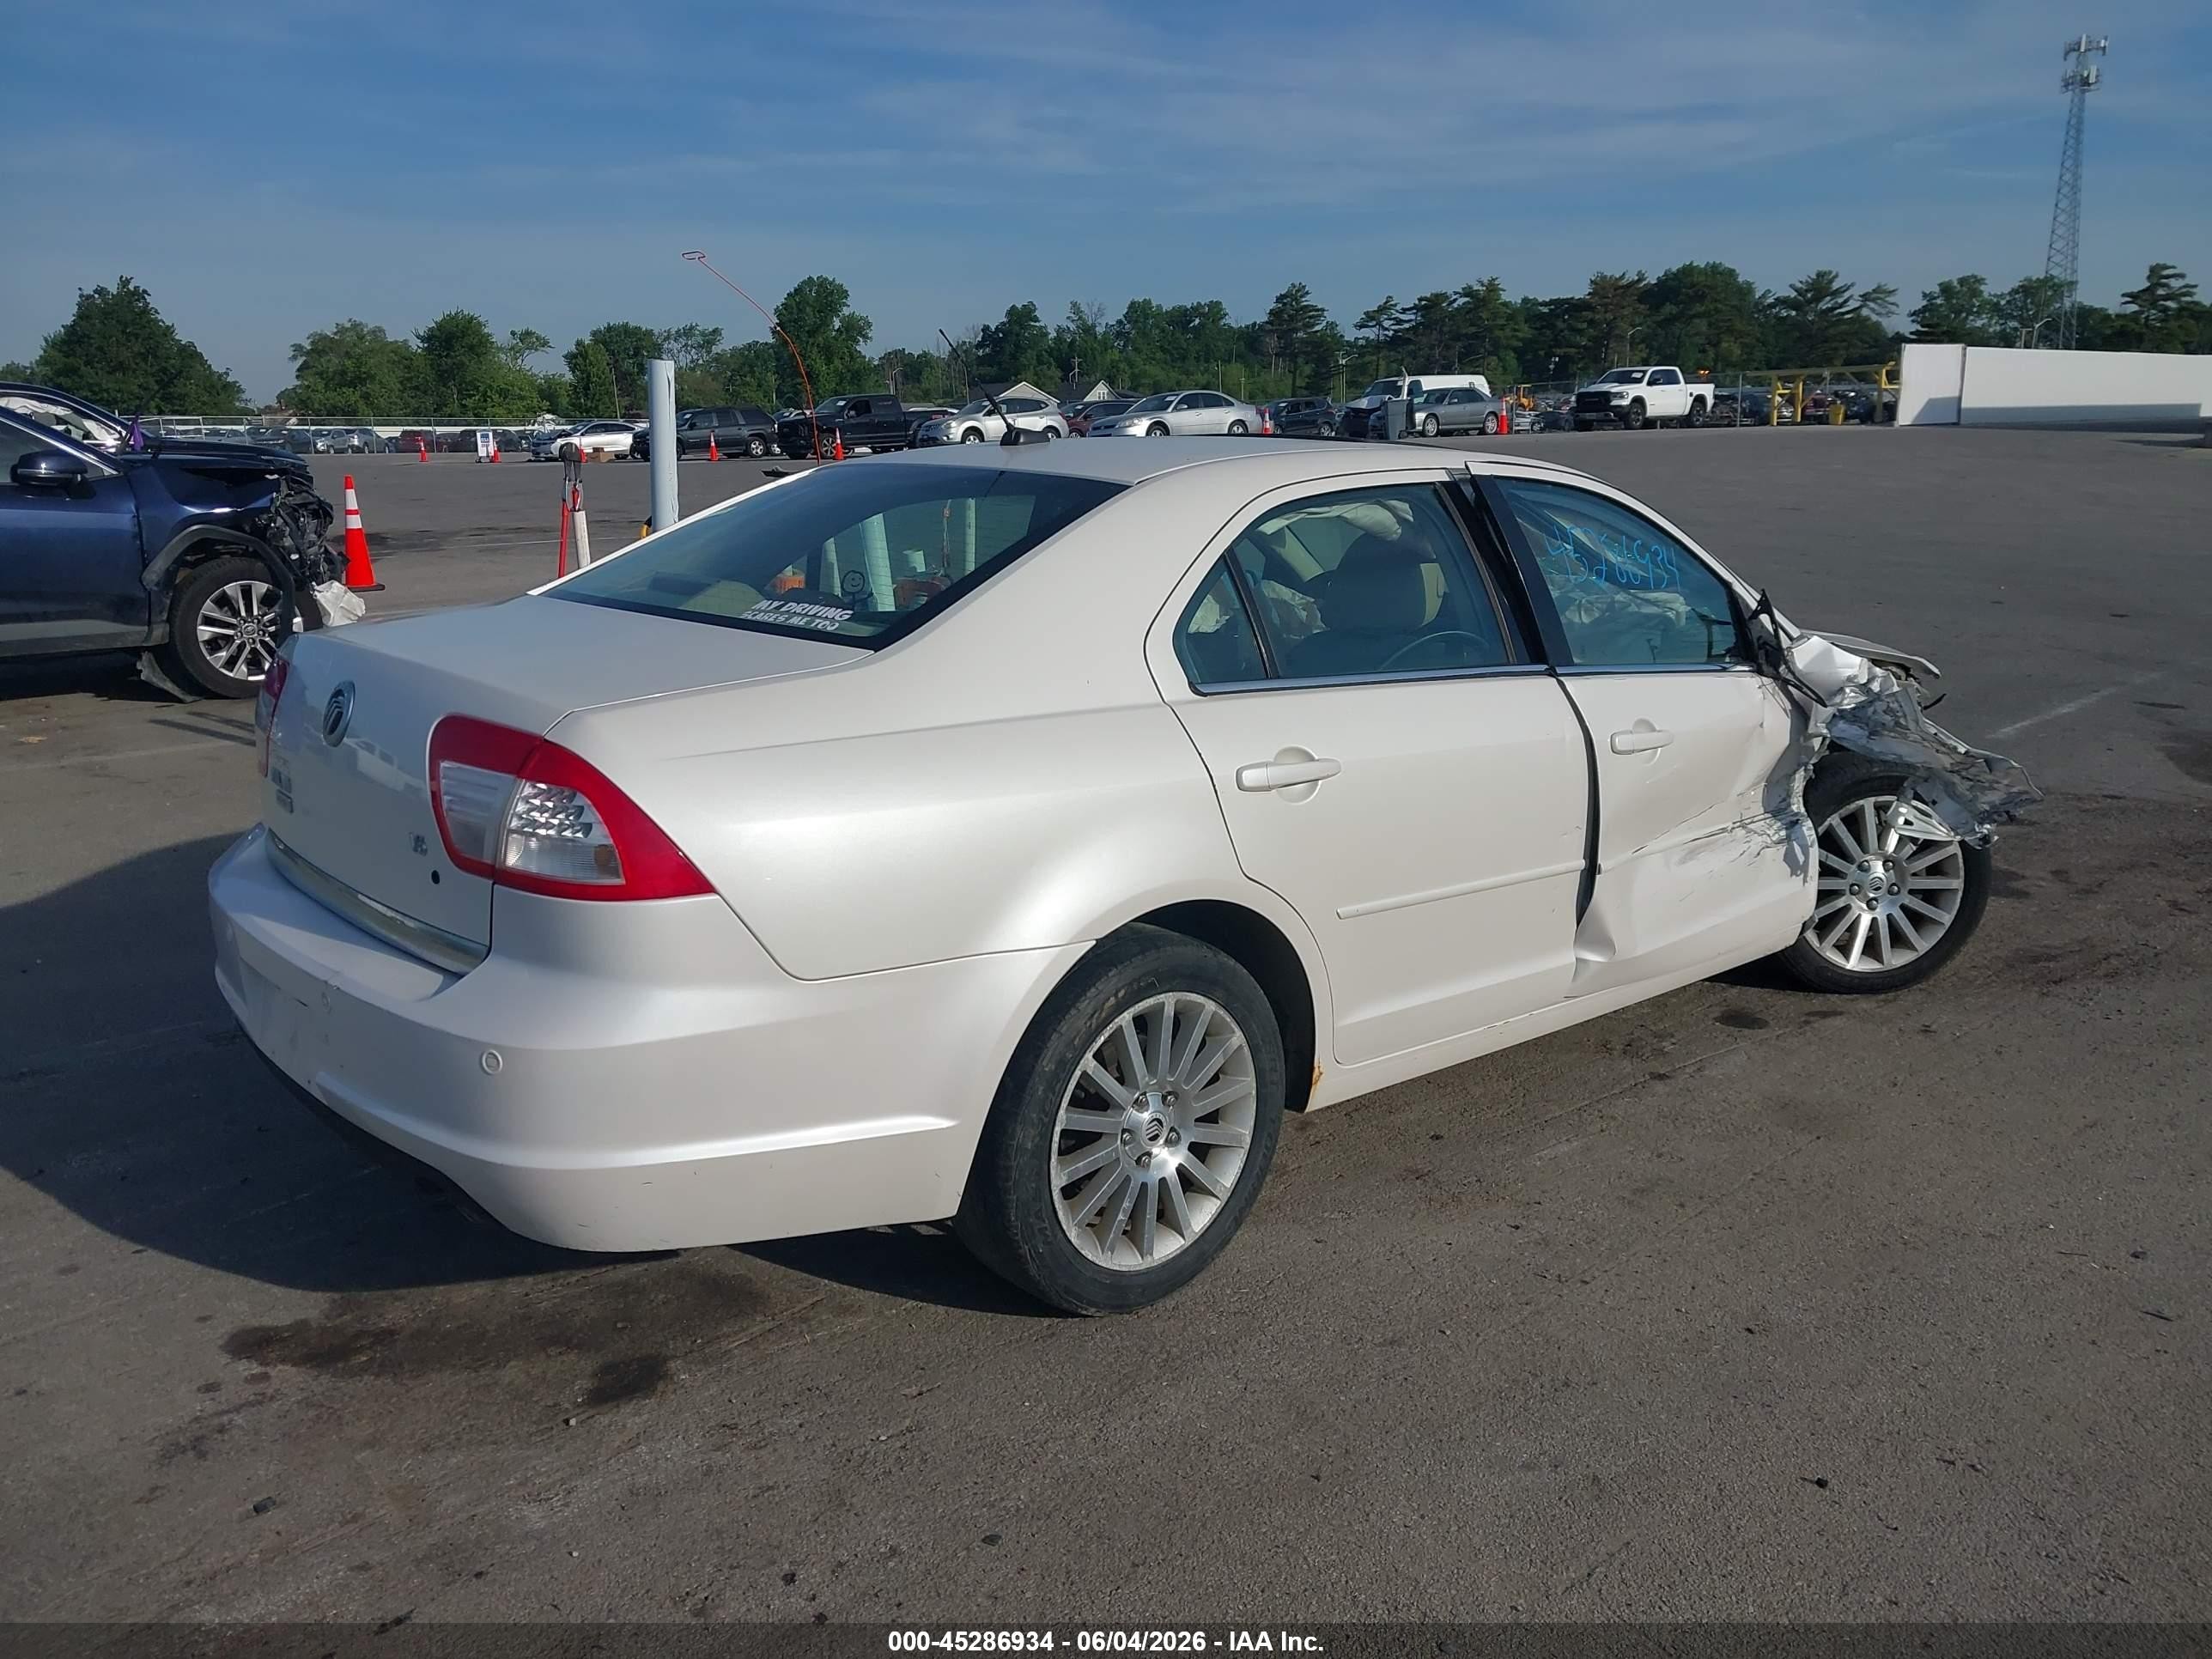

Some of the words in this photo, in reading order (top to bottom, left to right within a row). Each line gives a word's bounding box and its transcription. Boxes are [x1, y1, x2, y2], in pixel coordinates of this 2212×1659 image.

[751, 599, 782, 611] MY
[781, 602, 854, 621] DRIVING
[741, 611, 787, 623] SCARES
[787, 616, 809, 626] ME
[810, 618, 840, 631] TOO
